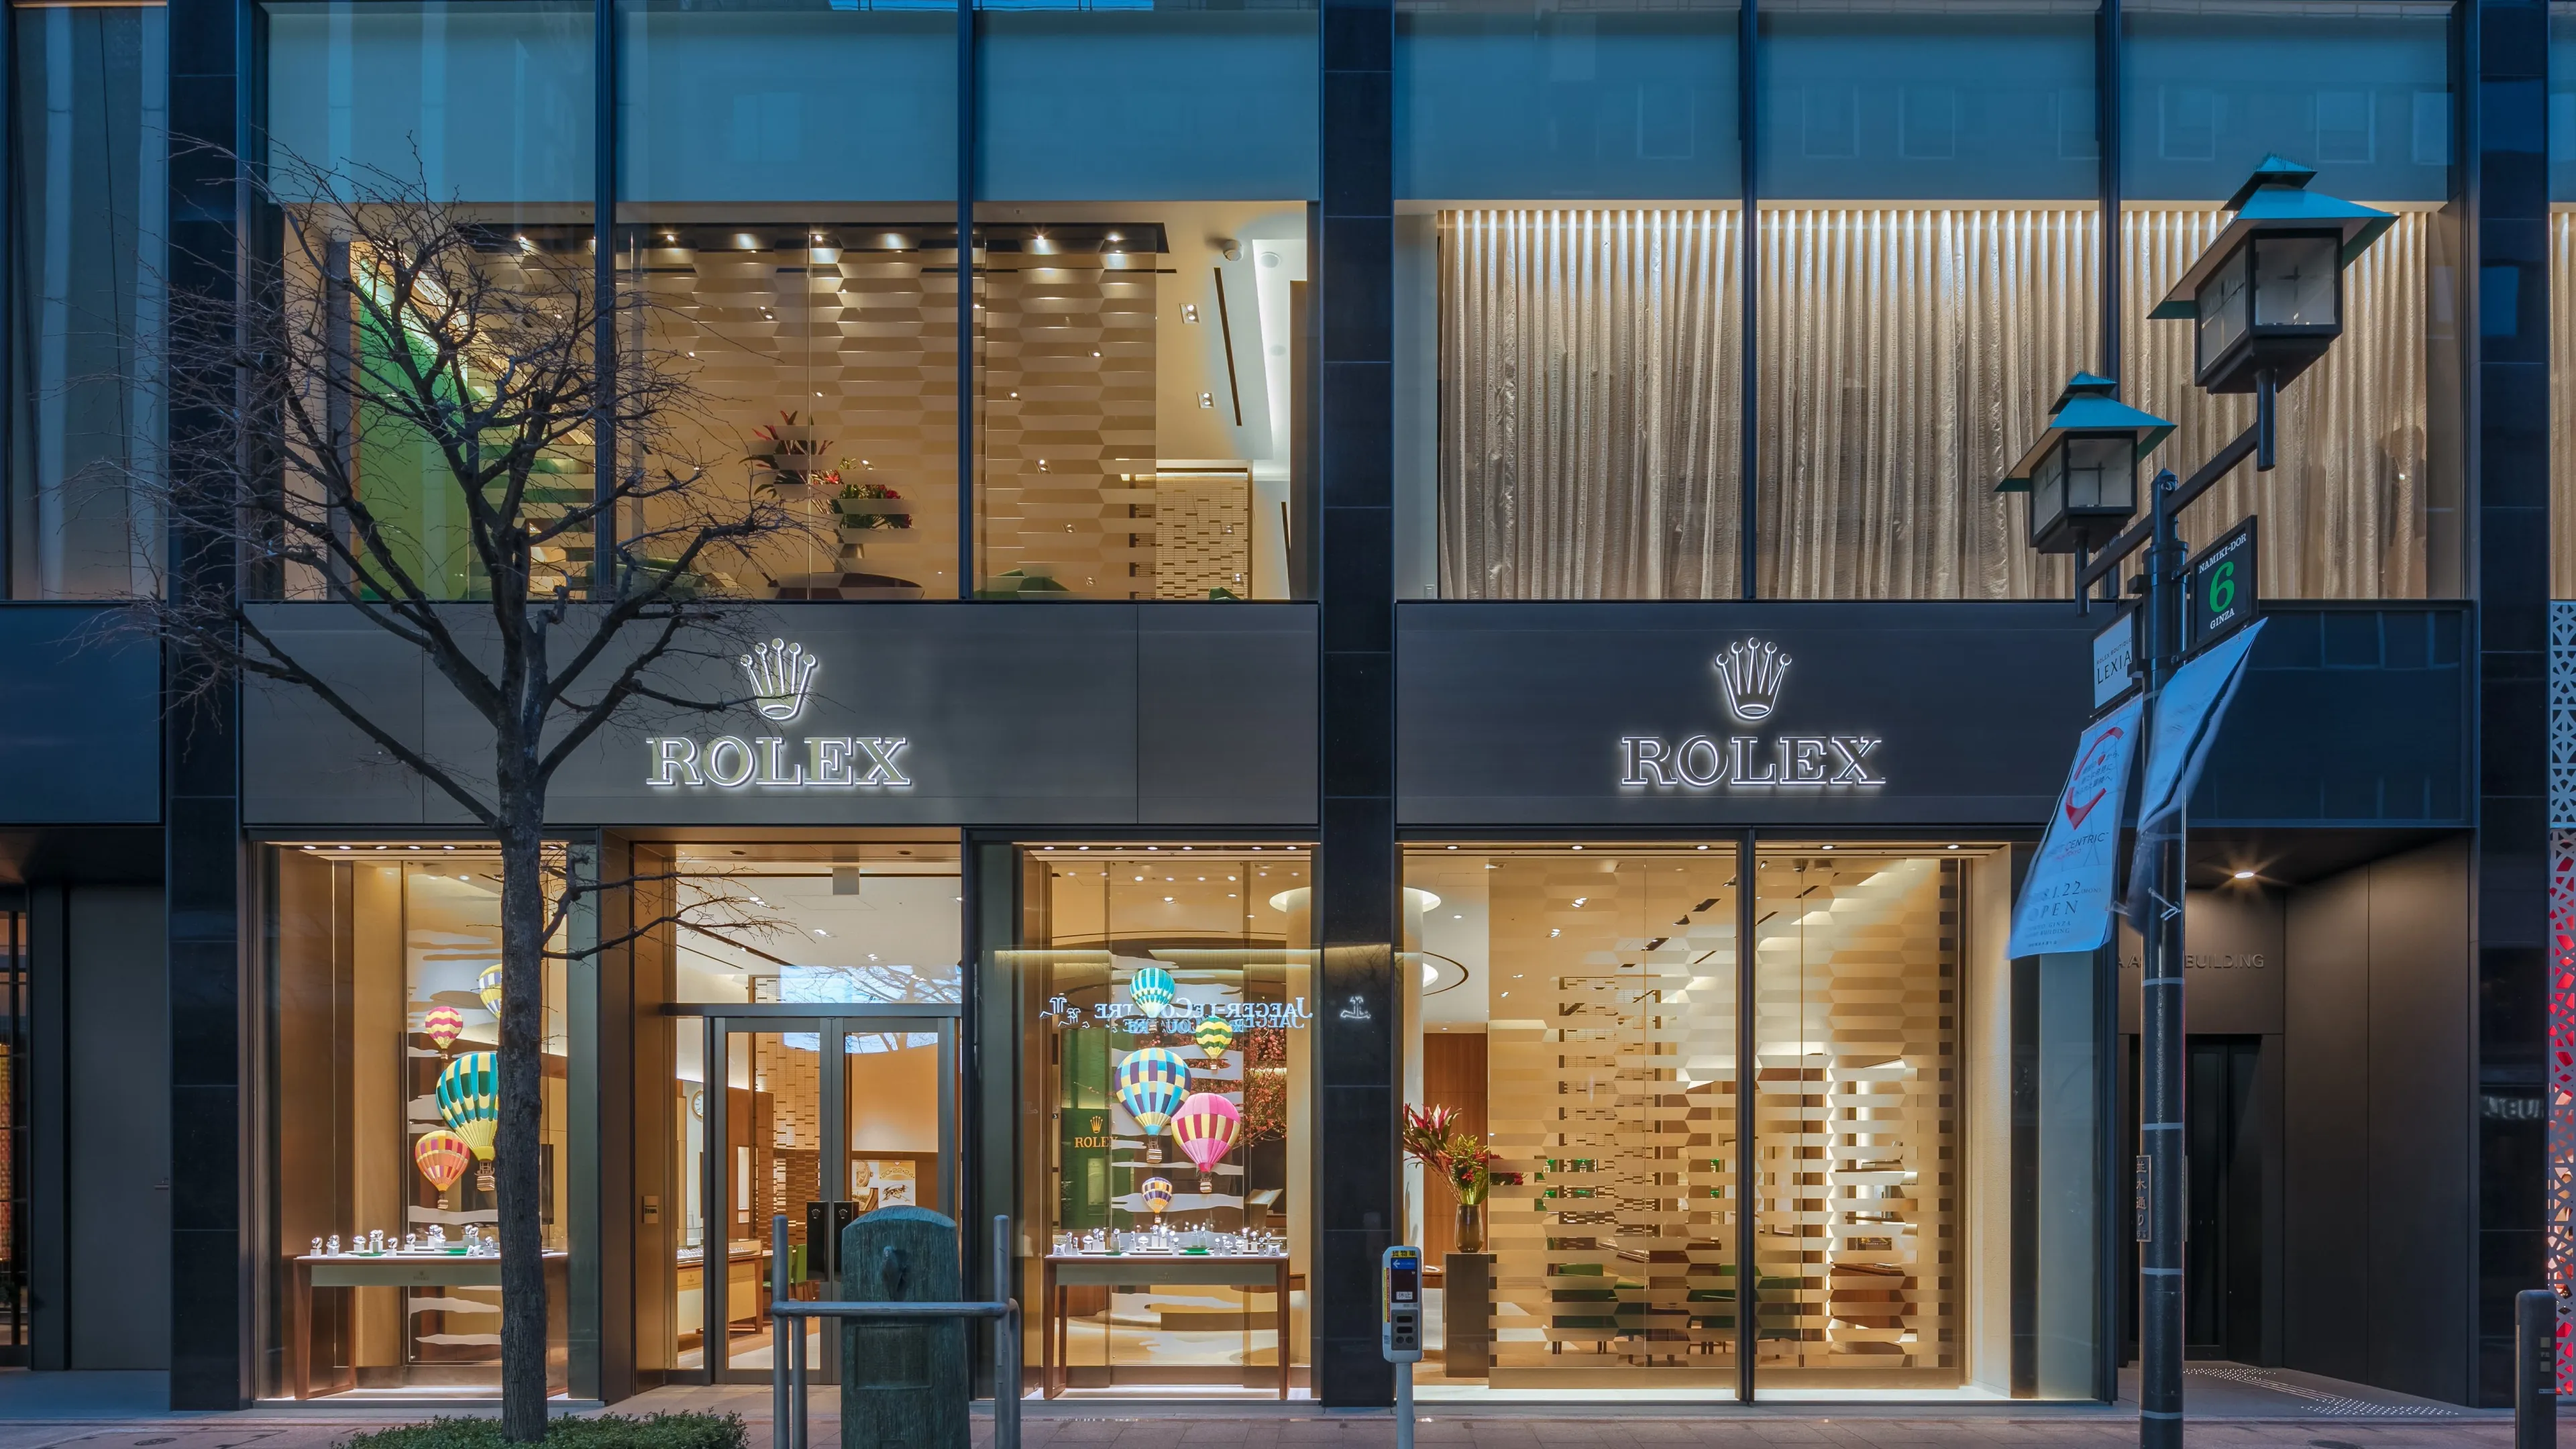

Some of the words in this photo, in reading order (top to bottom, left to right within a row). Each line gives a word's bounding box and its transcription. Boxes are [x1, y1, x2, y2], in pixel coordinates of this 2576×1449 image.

[2210, 561, 2235, 612] 6
[2210, 608, 2235, 629] GINZA
[2096, 653, 2110, 665] ROLEX
[2110, 637, 2133, 655] BOUTIQUE
[2097, 650, 2132, 685] LEXIA
[646, 736, 911, 786] ROLEX
[1621, 735, 1886, 786] ROLEX
[2066, 833, 2106, 851] CENTRIC
[2027, 900, 2079, 921] OPEN
[2184, 954, 2265, 969] BUILDING
